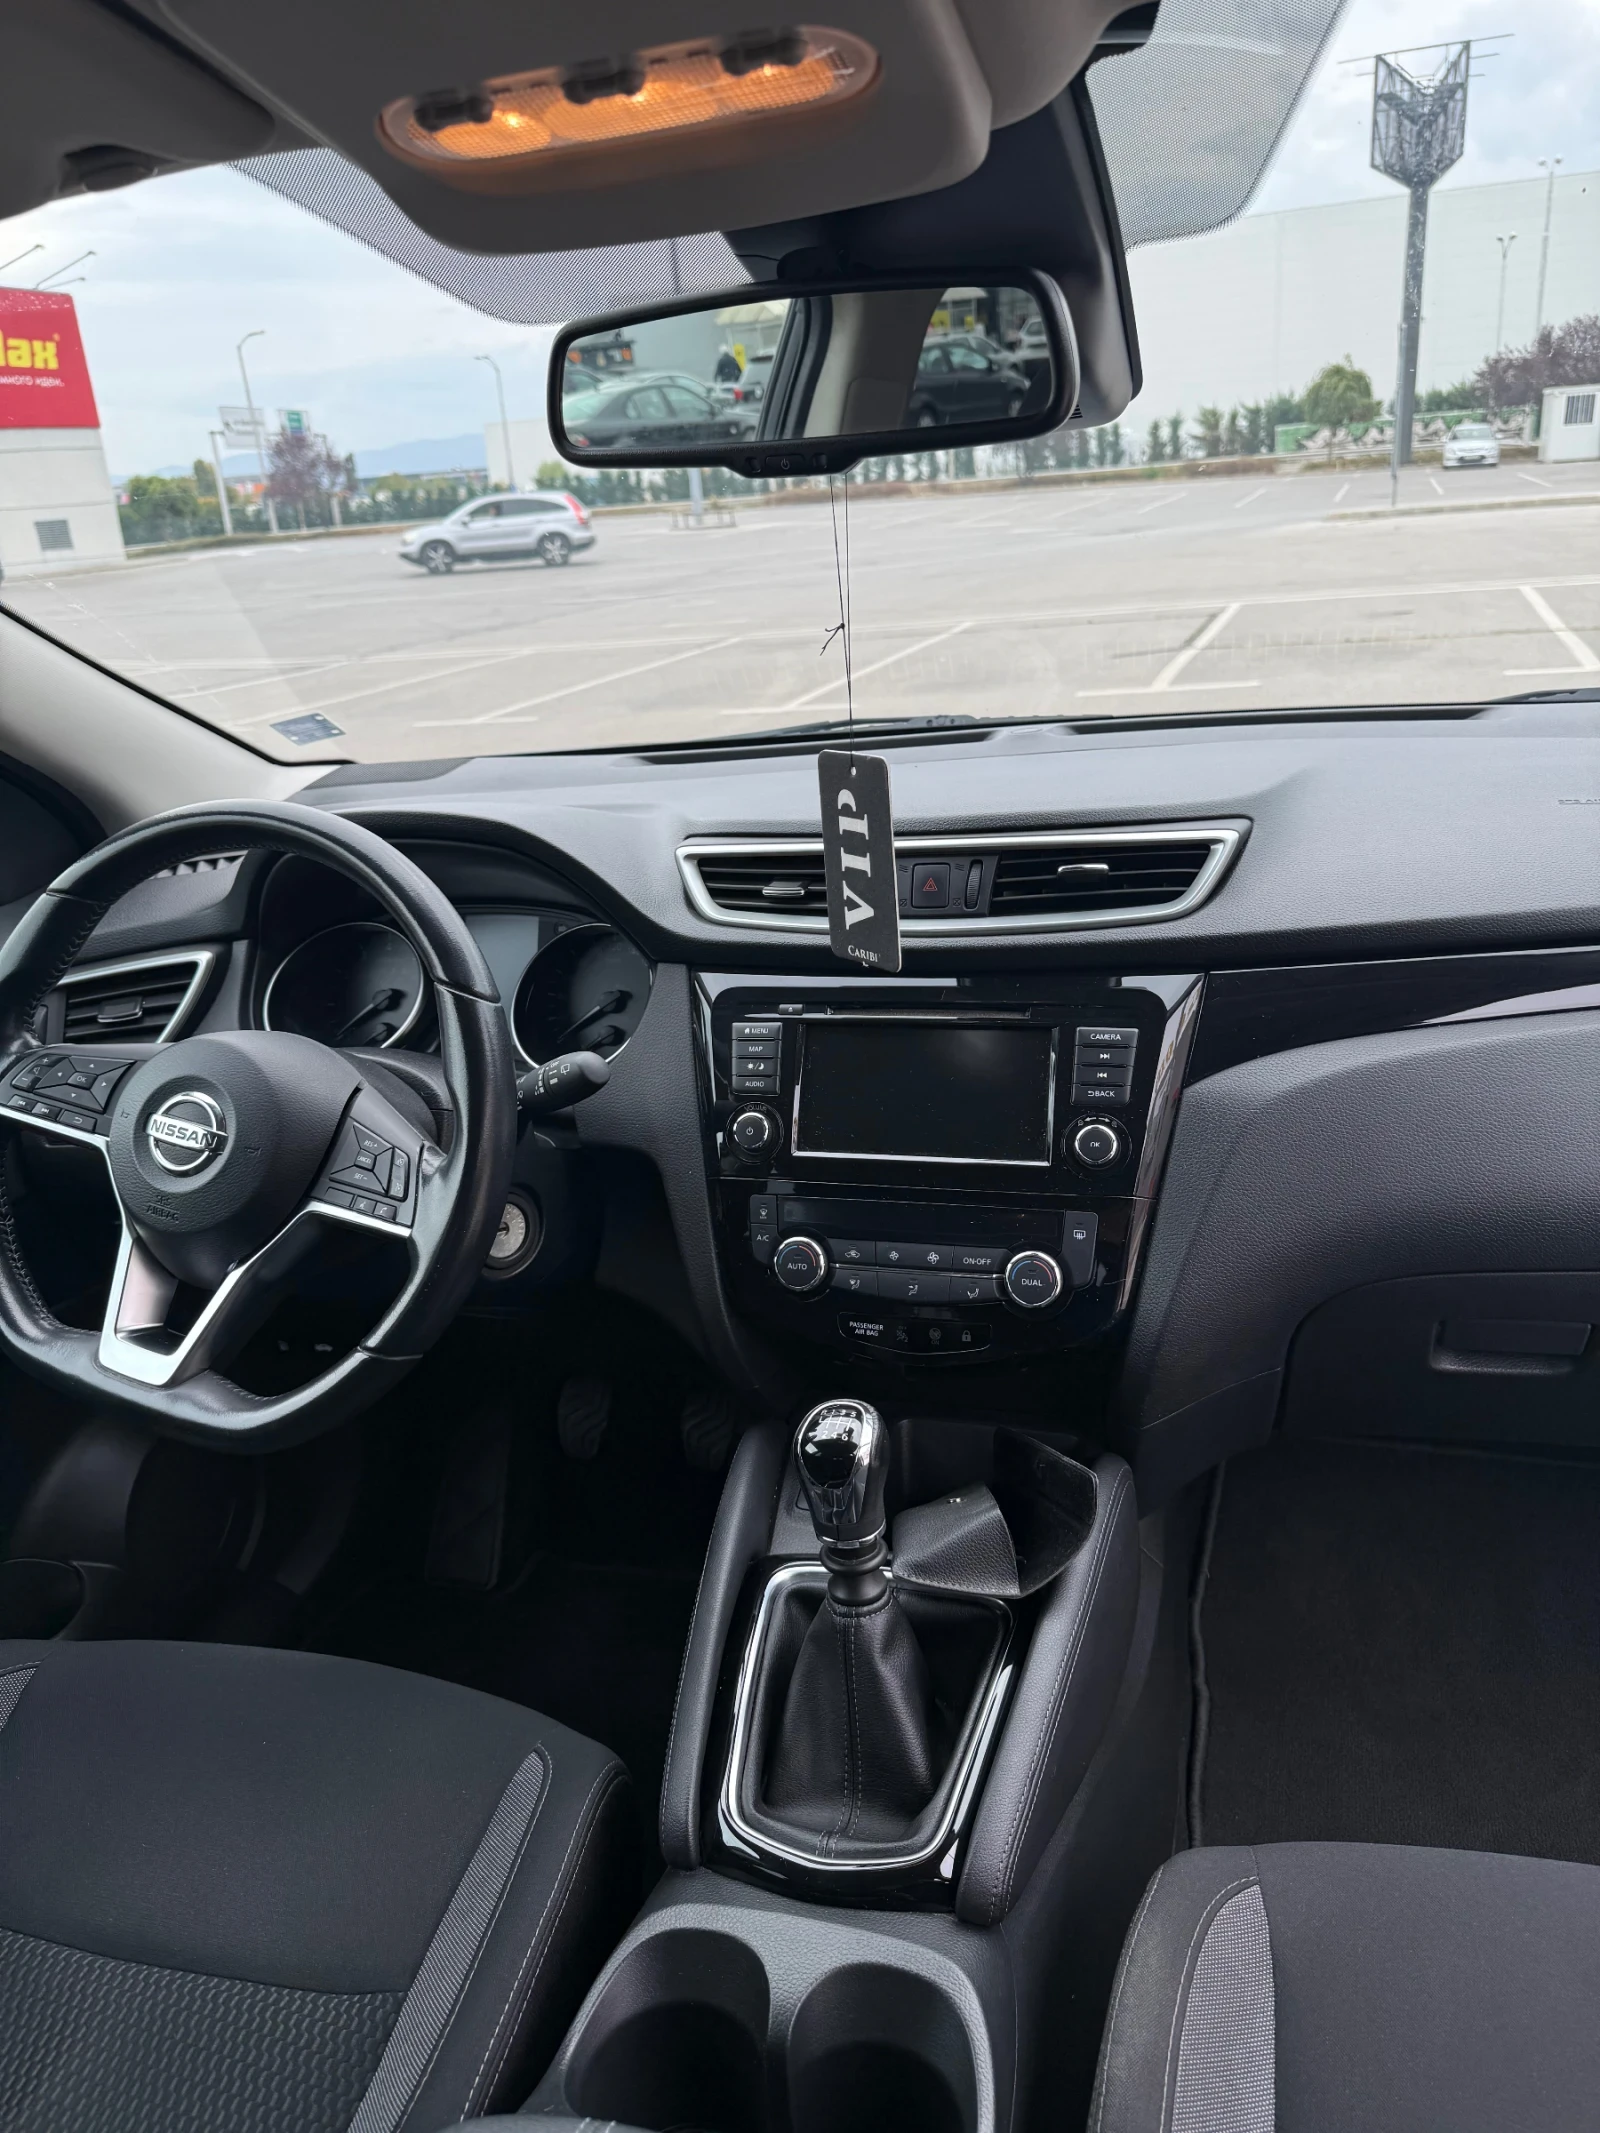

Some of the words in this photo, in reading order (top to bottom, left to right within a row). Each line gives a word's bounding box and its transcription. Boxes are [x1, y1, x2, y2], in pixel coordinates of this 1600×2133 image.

[837, 788, 875, 931] VIP
[76, 1075, 87, 1083] OK
[150, 1119, 218, 1148] NISSAN
[756, 1234, 770, 1242] A/C
[962, 1257, 992, 1265] ON-OFF
[787, 1262, 808, 1270] AUTO
[1021, 1278, 1043, 1286] DUAL
[849, 1321, 884, 1331] PASSENGER
[822, 1431, 828, 1439] 2
[831, 1431, 837, 1439] 4
[842, 1433, 849, 1441] 6
